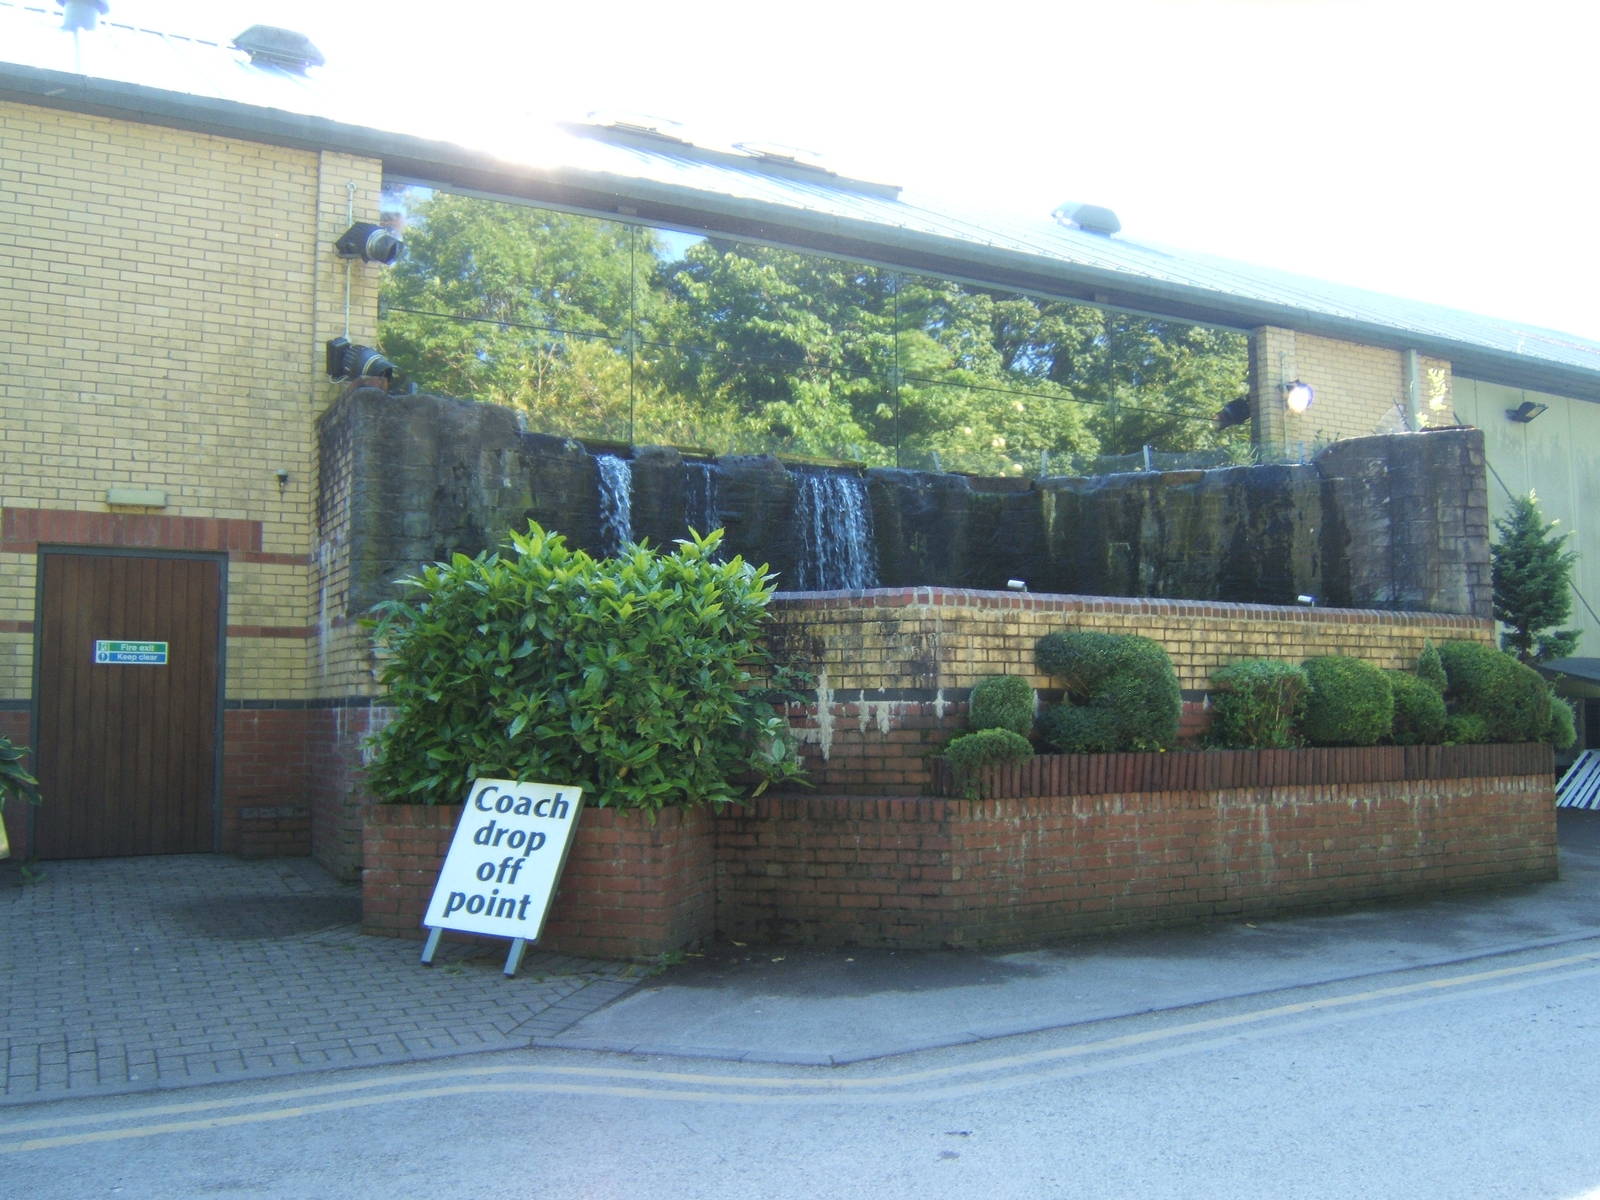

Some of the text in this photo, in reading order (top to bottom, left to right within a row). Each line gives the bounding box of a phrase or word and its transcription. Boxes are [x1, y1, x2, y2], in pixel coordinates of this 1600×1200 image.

[117, 653, 137, 661] Keep
[120, 643, 137, 651] Fire
[474, 786, 570, 819] Coach
[473, 820, 546, 857] drop
[476, 856, 526, 885] off
[442, 888, 531, 920] point
